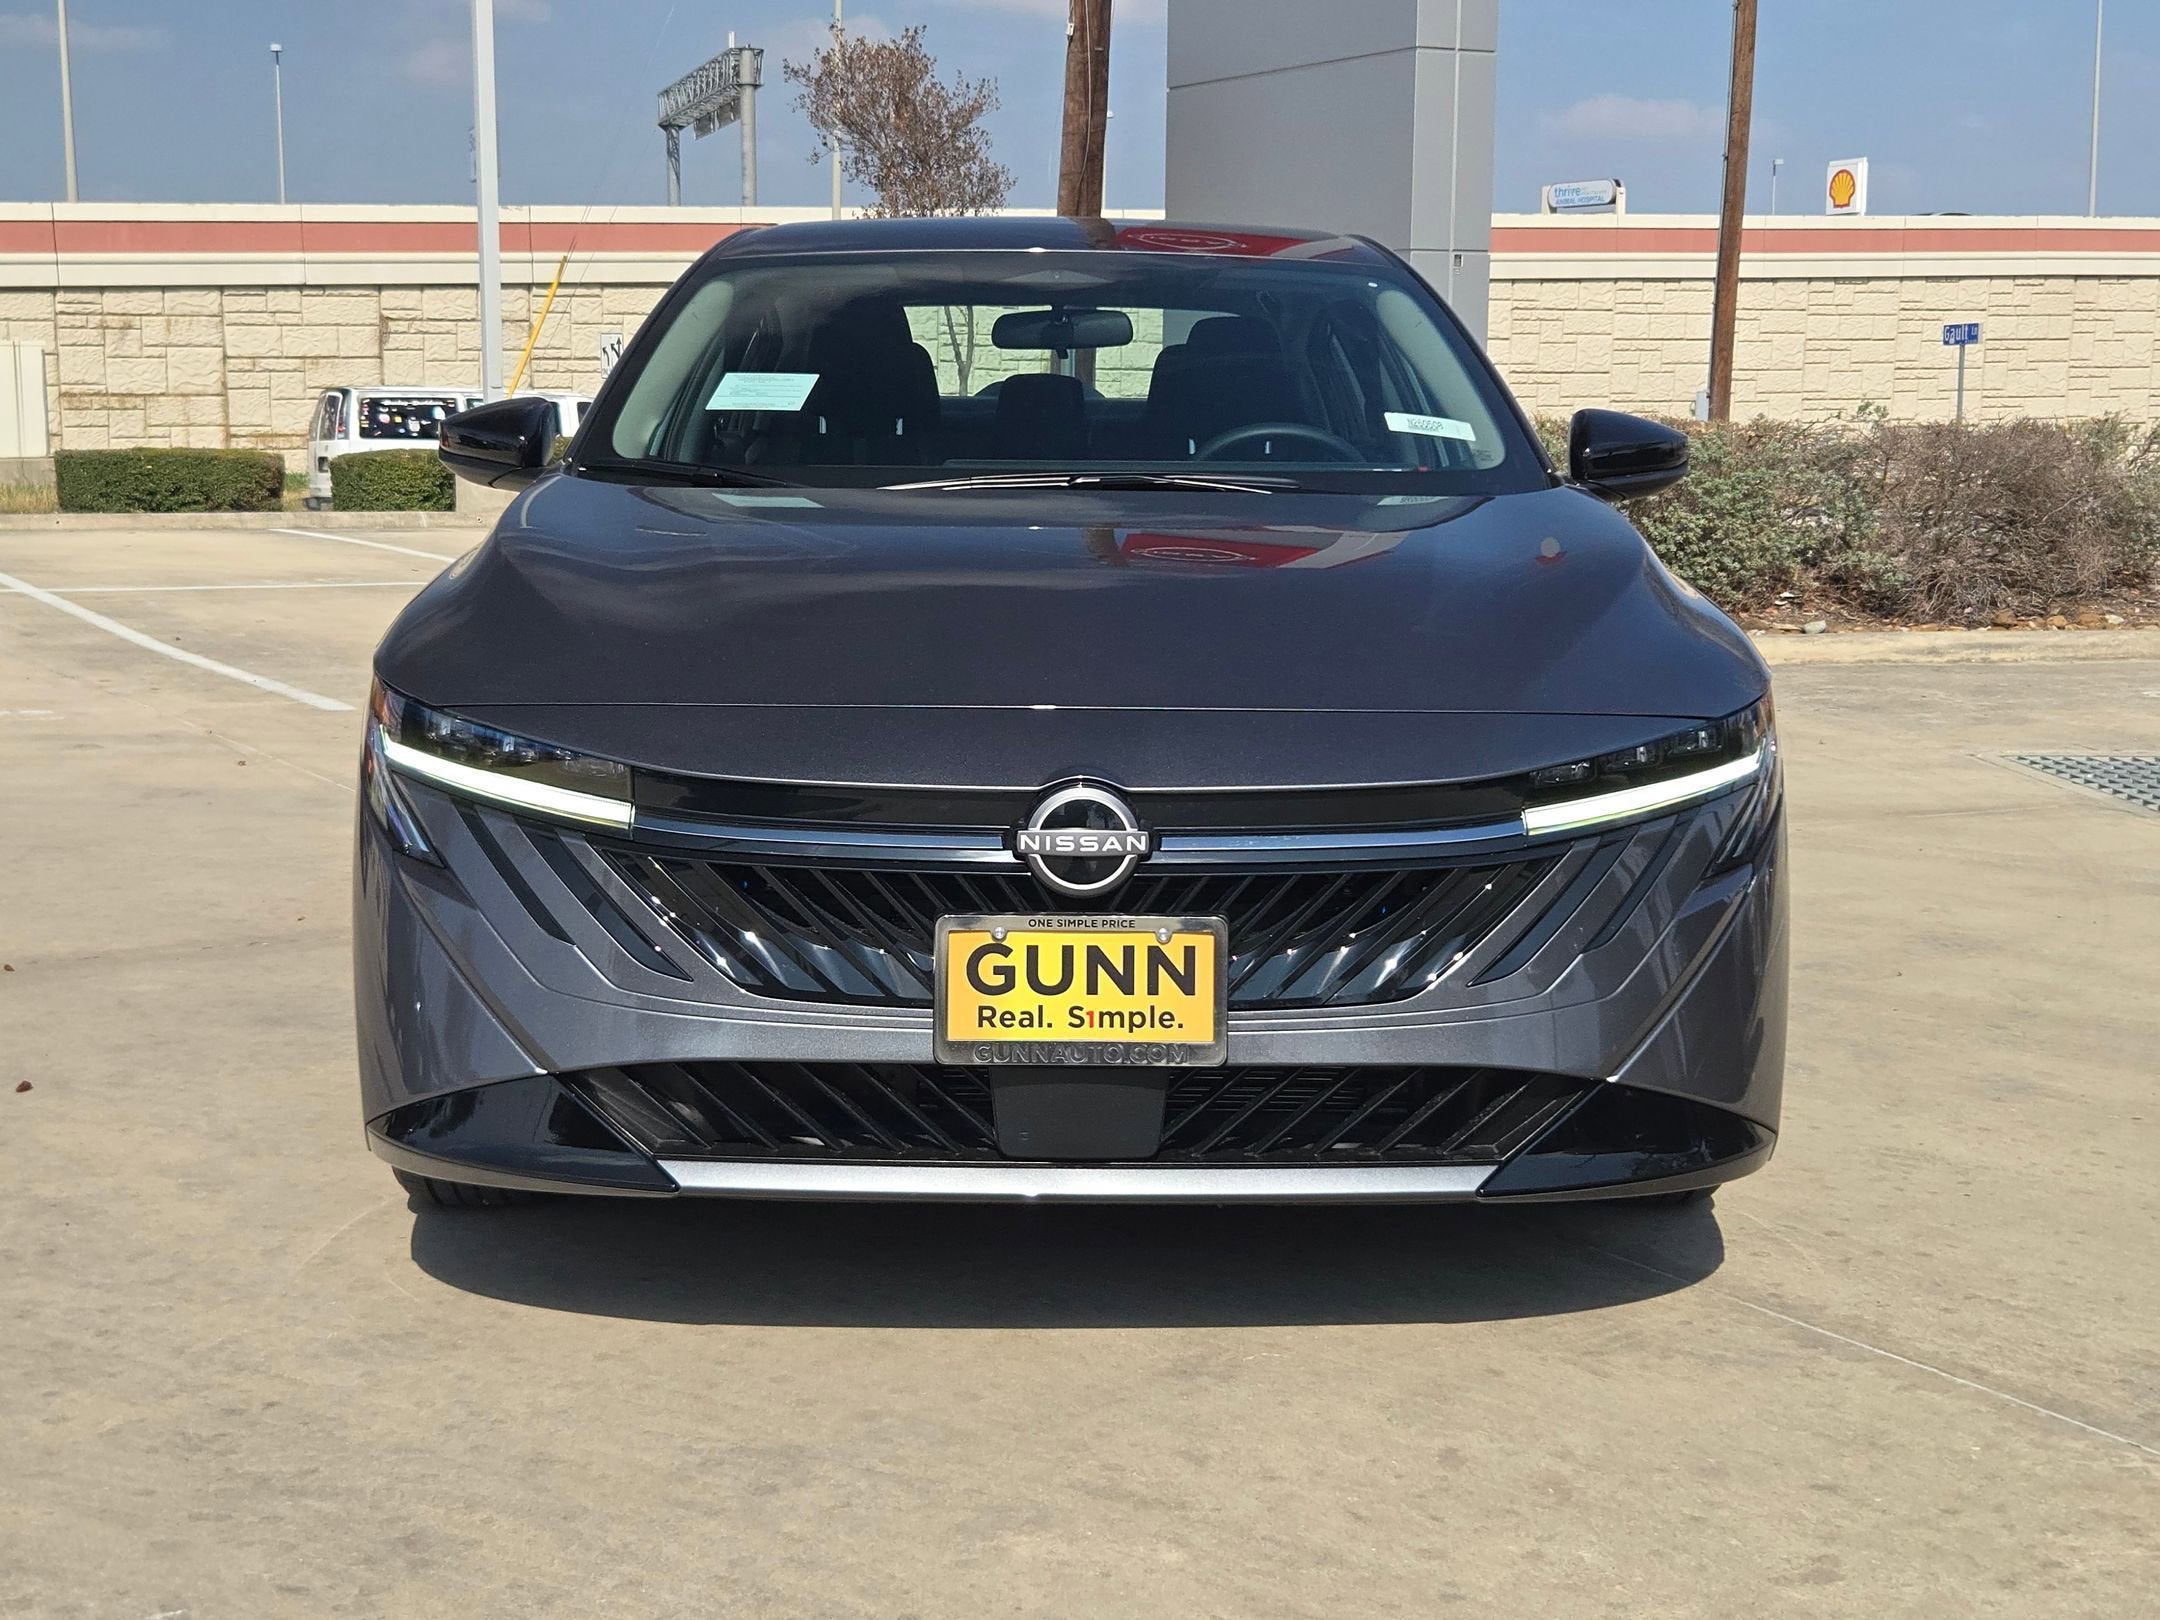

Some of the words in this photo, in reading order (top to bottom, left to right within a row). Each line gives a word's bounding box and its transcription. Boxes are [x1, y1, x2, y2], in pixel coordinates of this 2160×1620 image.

[1554, 185, 1580, 197] thrive
[1555, 197, 1577, 205] ANIMAL
[1577, 194, 1606, 203] HOSPITAL
[1944, 324, 1968, 341] Gault
[1019, 834, 1146, 852] NISSAN
[1028, 918, 1054, 928] ONE
[1056, 919, 1098, 928] SIMPLE
[1101, 919, 1136, 928] PRICE
[966, 942, 1196, 996] GUNN
[977, 1004, 1053, 1029] Real.
[973, 1042, 1191, 1064] GUNNAUTO.COM
